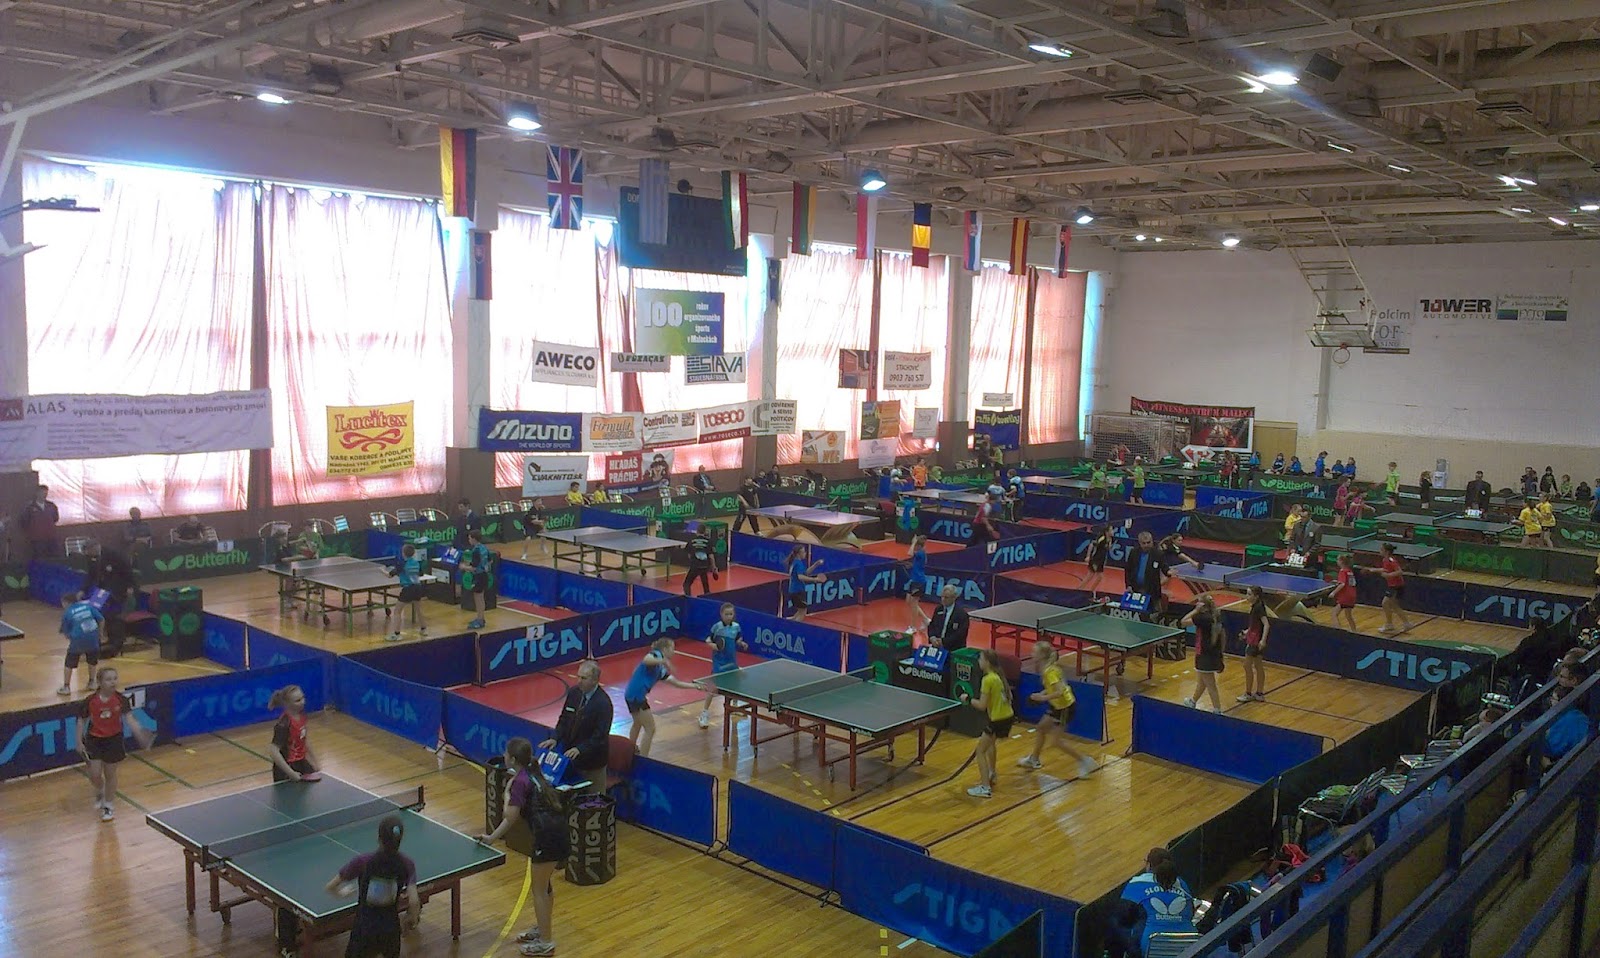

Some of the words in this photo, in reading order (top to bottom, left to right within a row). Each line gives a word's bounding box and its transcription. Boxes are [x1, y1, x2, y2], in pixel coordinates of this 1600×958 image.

[643, 301, 683, 327] 100
[1420, 299, 1492, 313] TOWER
[535, 351, 595, 371] AWECO
[27, 402, 66, 414] ALAS
[930, 520, 974, 539] STIG
[185, 550, 248, 569] Butterfly
[991, 542, 1036, 568] STIGA
[600, 608, 680, 646] STIGA
[489, 628, 583, 671] STIGA
[755, 627, 805, 655] JOOLA
[912, 667, 942, 684] Butterfly
[1357, 649, 1472, 683] STIGA
